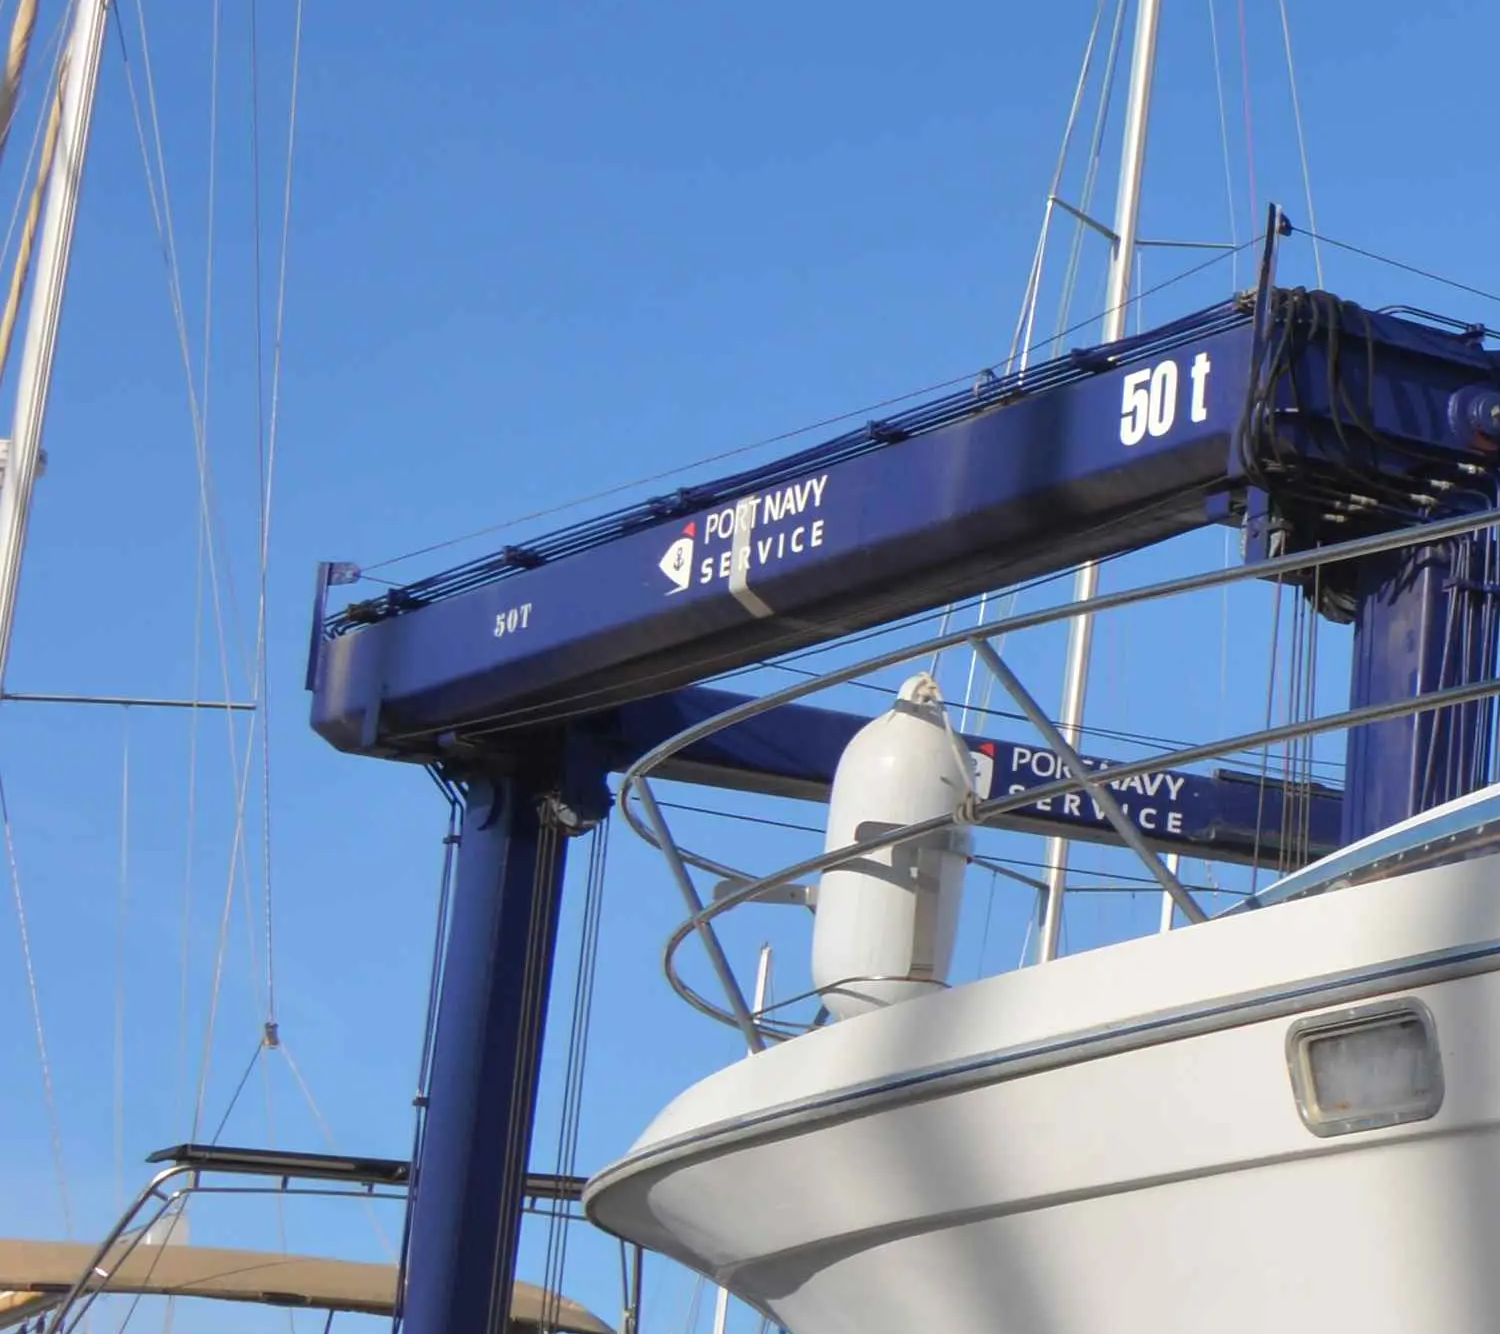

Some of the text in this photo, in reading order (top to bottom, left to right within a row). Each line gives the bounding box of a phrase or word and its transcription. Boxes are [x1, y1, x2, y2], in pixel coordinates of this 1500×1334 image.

[1120, 352, 1210, 446] 50 t
[704, 475, 828, 545] PORT NAVY
[701, 520, 824, 584] SERVICE
[493, 602, 532, 638] 50T
